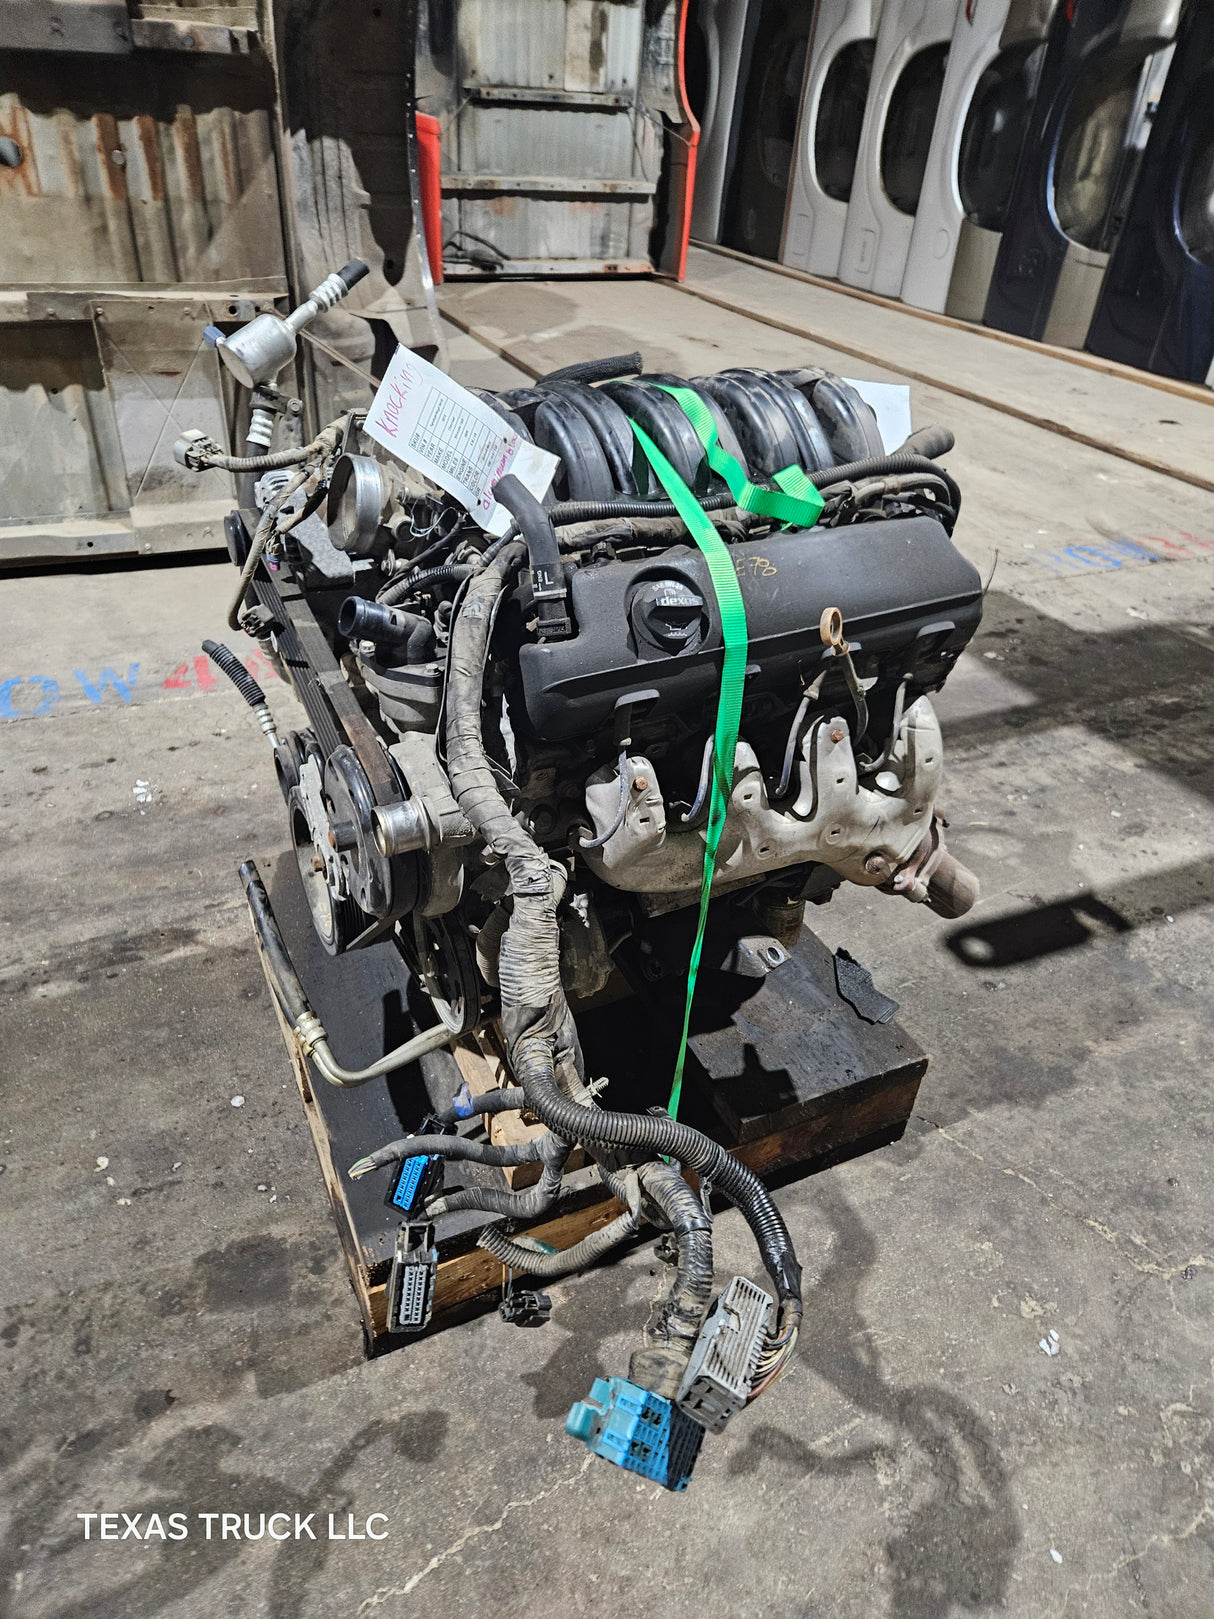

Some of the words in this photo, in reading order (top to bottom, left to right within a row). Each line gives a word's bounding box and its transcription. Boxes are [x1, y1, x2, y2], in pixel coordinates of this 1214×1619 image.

[427, 443, 435, 458] YEAR
[434, 447, 443, 463] MAKE
[442, 450, 452, 469] MODEL
[660, 597, 700, 607] dexos
